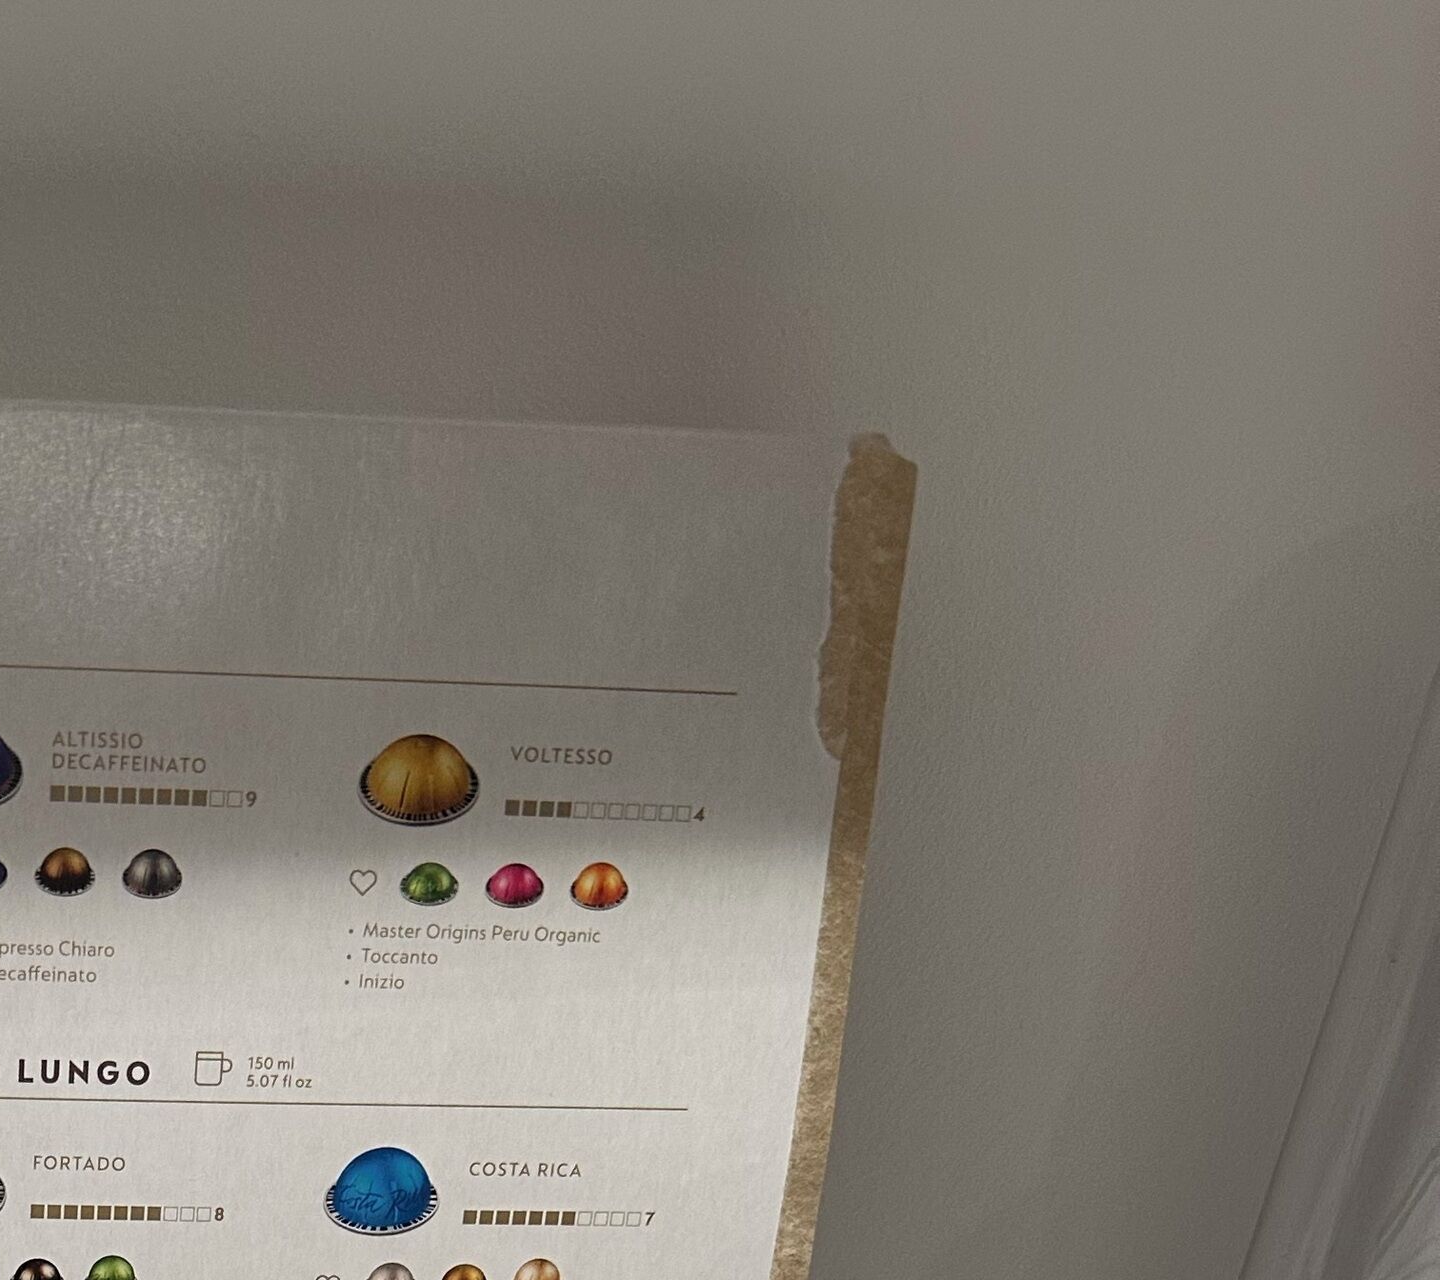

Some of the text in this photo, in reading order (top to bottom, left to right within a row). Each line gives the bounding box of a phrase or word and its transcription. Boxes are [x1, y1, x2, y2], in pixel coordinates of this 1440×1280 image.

[52, 731, 144, 750] ALTISSIO
[52, 753, 207, 774] DECAFFEINATO
[511, 746, 613, 766] VOLTESSO
[246, 791, 257, 808] 9
[693, 807, 705, 822] 4
[362, 923, 601, 946] Master Origins Peru Organic
[59, 941, 115, 958] Chiaro
[361, 948, 438, 965] Toccanto
[358, 974, 405, 990] Inizio
[18, 1058, 151, 1086] LUNGO
[248, 1057, 294, 1070] 150 ml
[246, 1074, 312, 1089] 5.07 fl oz
[33, 1156, 126, 1172] FORTADO
[469, 1161, 582, 1178] COSTA RICA
[215, 1208, 224, 1222] 8
[645, 1212, 655, 1226] 7
